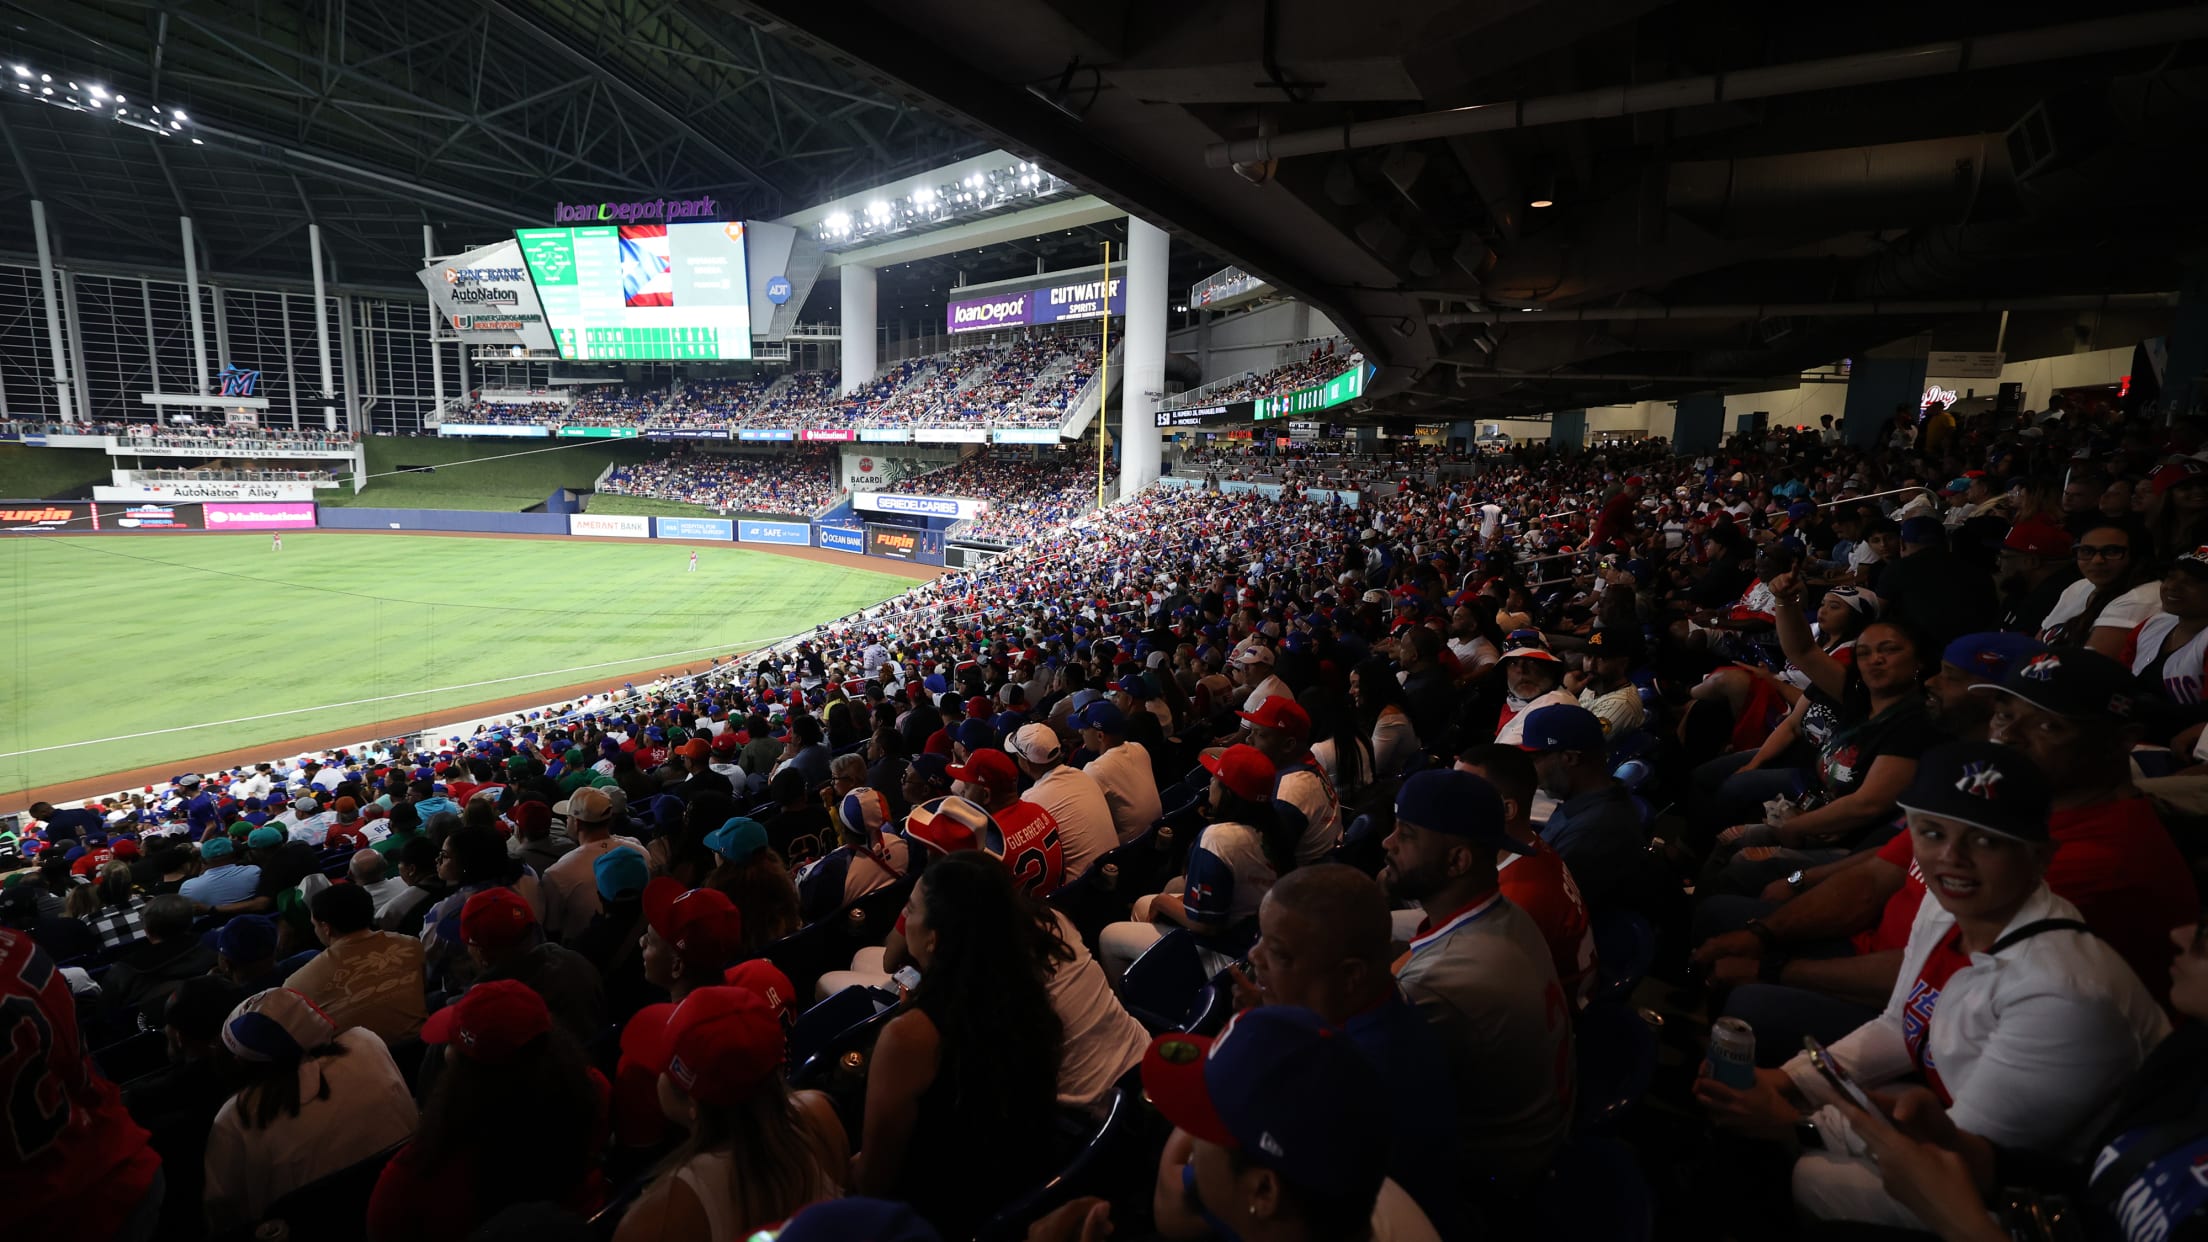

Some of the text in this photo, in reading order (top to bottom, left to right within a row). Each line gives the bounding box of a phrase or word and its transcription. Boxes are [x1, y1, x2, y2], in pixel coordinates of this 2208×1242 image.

[557, 196, 717, 223] loanDepot park
[458, 267, 525, 282] PNC BANK
[451, 288, 516, 302] AutoNation
[769, 285, 788, 296] ADT
[954, 297, 1025, 324] loanDepot
[1069, 302, 1096, 314] SPIRITS
[813, 431, 848, 440] Multinational
[225, 450, 280, 458] PARTNERS
[173, 487, 278, 499] AutoNation Alley
[228, 511, 313, 524] Multinational
[576, 522, 643, 532] AMERANT BANK
[763, 528, 781, 537] SAFE
[829, 534, 862, 546] OCEAN BANK
[1006, 816, 1046, 851] GUERRERO
[766, 985, 782, 1009] JR
